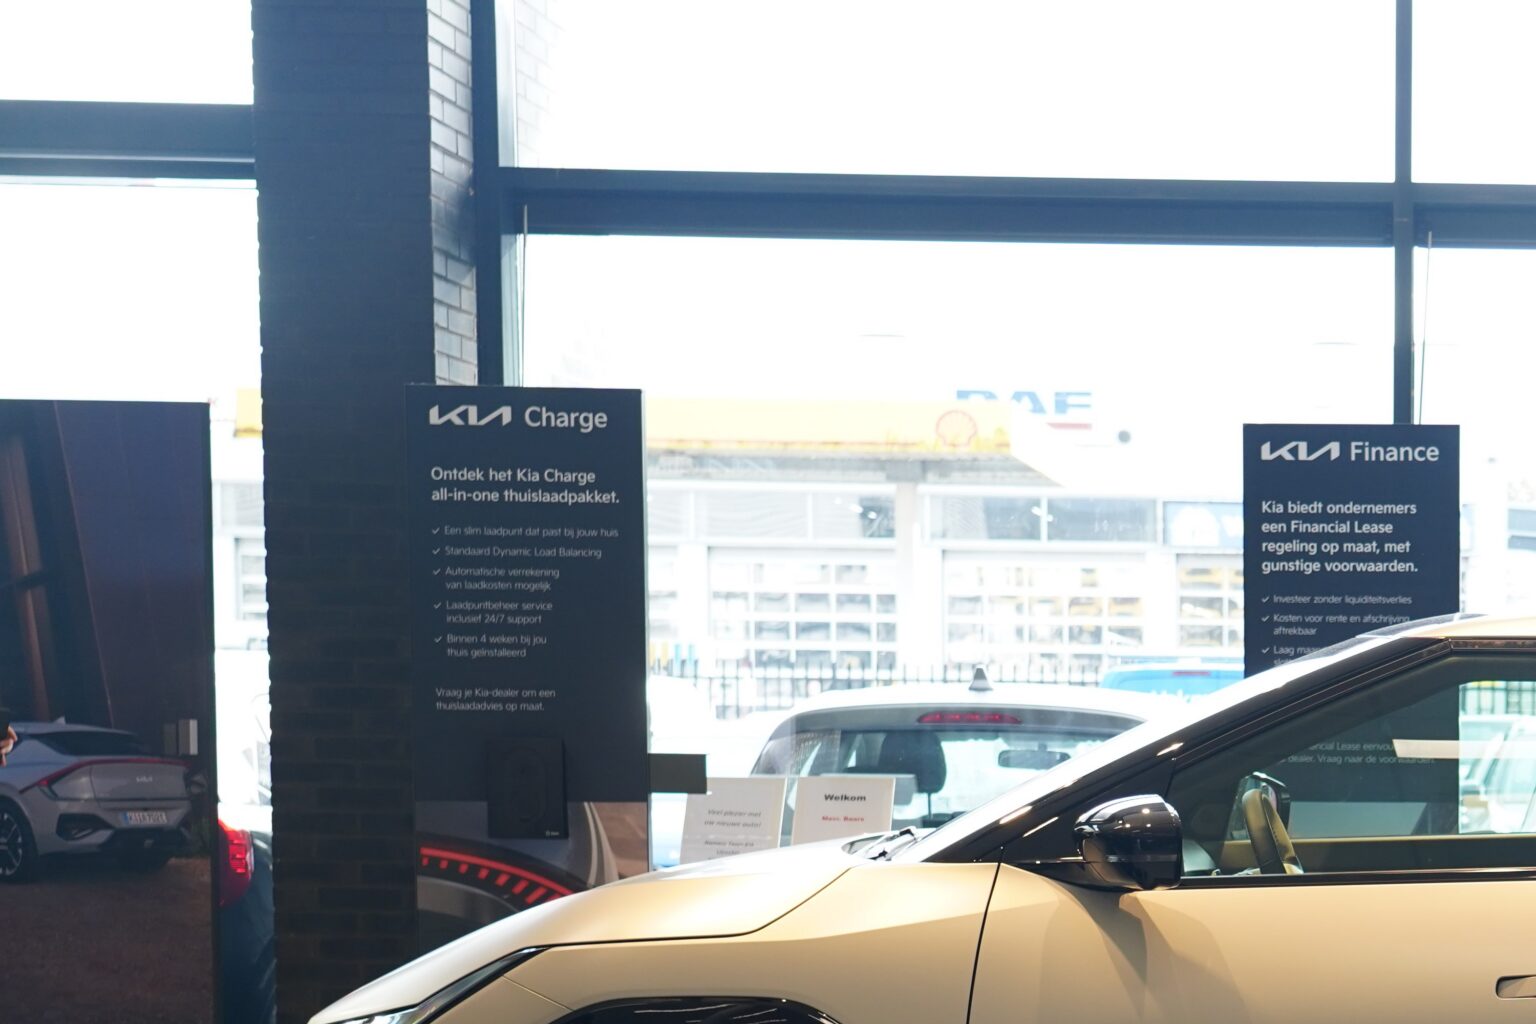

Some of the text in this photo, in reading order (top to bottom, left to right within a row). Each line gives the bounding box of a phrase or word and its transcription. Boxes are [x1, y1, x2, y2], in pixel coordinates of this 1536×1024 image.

[429, 404, 608, 433] KIA Charge
[1261, 441, 1440, 462] KIA Finance
[431, 467, 596, 486] Ontdek het Kia Charge
[431, 488, 620, 506] all-in-one thuislaadpakket.
[1261, 501, 1417, 515] Kia biedt ondernemers
[444, 527, 619, 539] Een slim laadpunt dat past bij jouw huis
[1261, 520, 1393, 534] een Financial Lease
[444, 547, 602, 560] Standaard Dynamic Load Balancing
[1261, 539, 1411, 556] regeling op maat, met
[1261, 559, 1418, 574] gunstige voorwaarden.
[445, 567, 560, 579] Automatische verrekening
[445, 582, 462, 590] van
[464, 580, 512, 590] laadkosten
[1273, 595, 1311, 604] Investeer
[1313, 595, 1342, 604] zonder
[446, 601, 553, 613] Laadpuntbeheer service
[446, 614, 542, 627] inclusief 24/7 support
[1273, 614, 1303, 623] Kosten
[1305, 615, 1323, 623] voor
[1326, 614, 1348, 623] rente
[1273, 626, 1317, 636] aftrekbaar
[447, 634, 547, 646] Binnen 4 weken bij jou
[447, 648, 469, 657] thuis
[1273, 645, 1294, 656] Laag
[435, 688, 556, 699] Vraag je Kia-dealer om een
[505, 703, 518, 713] op
[520, 702, 545, 712] maat.
[1336, 742, 1361, 751] Lease
[1317, 754, 1342, 765] Vraag
[1365, 755, 1376, 763] de
[824, 793, 866, 802] Welkom
